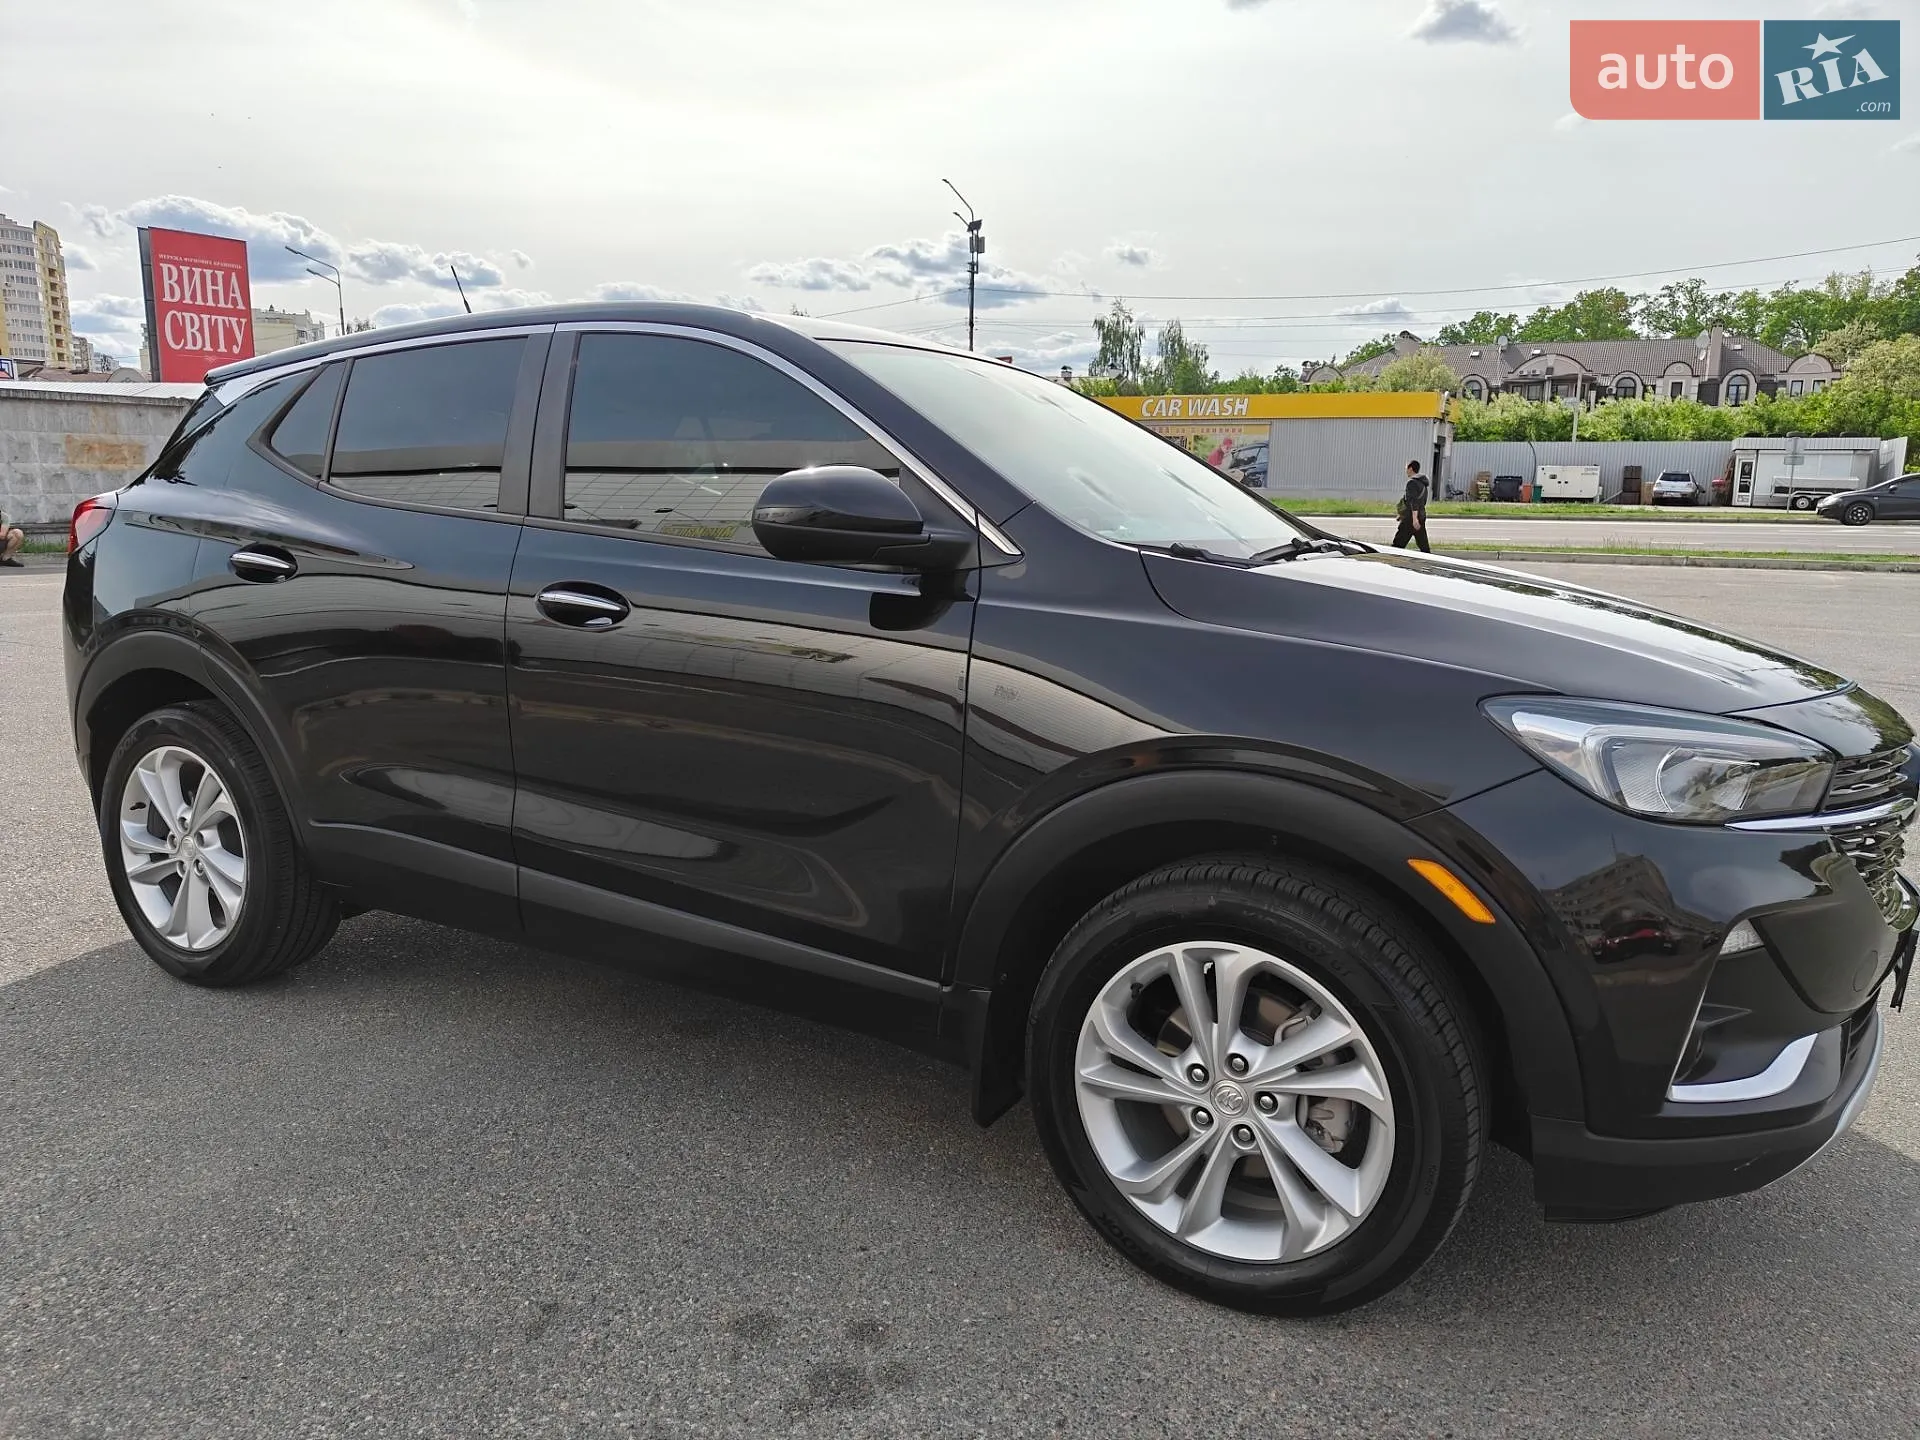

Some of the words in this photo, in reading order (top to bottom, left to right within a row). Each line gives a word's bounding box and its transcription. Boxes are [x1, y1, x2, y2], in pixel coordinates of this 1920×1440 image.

[160, 263, 246, 309] ВИНА
[164, 309, 247, 354] СВІТУ
[1141, 399, 1182, 417] CAR
[1188, 397, 1248, 416] WASH
